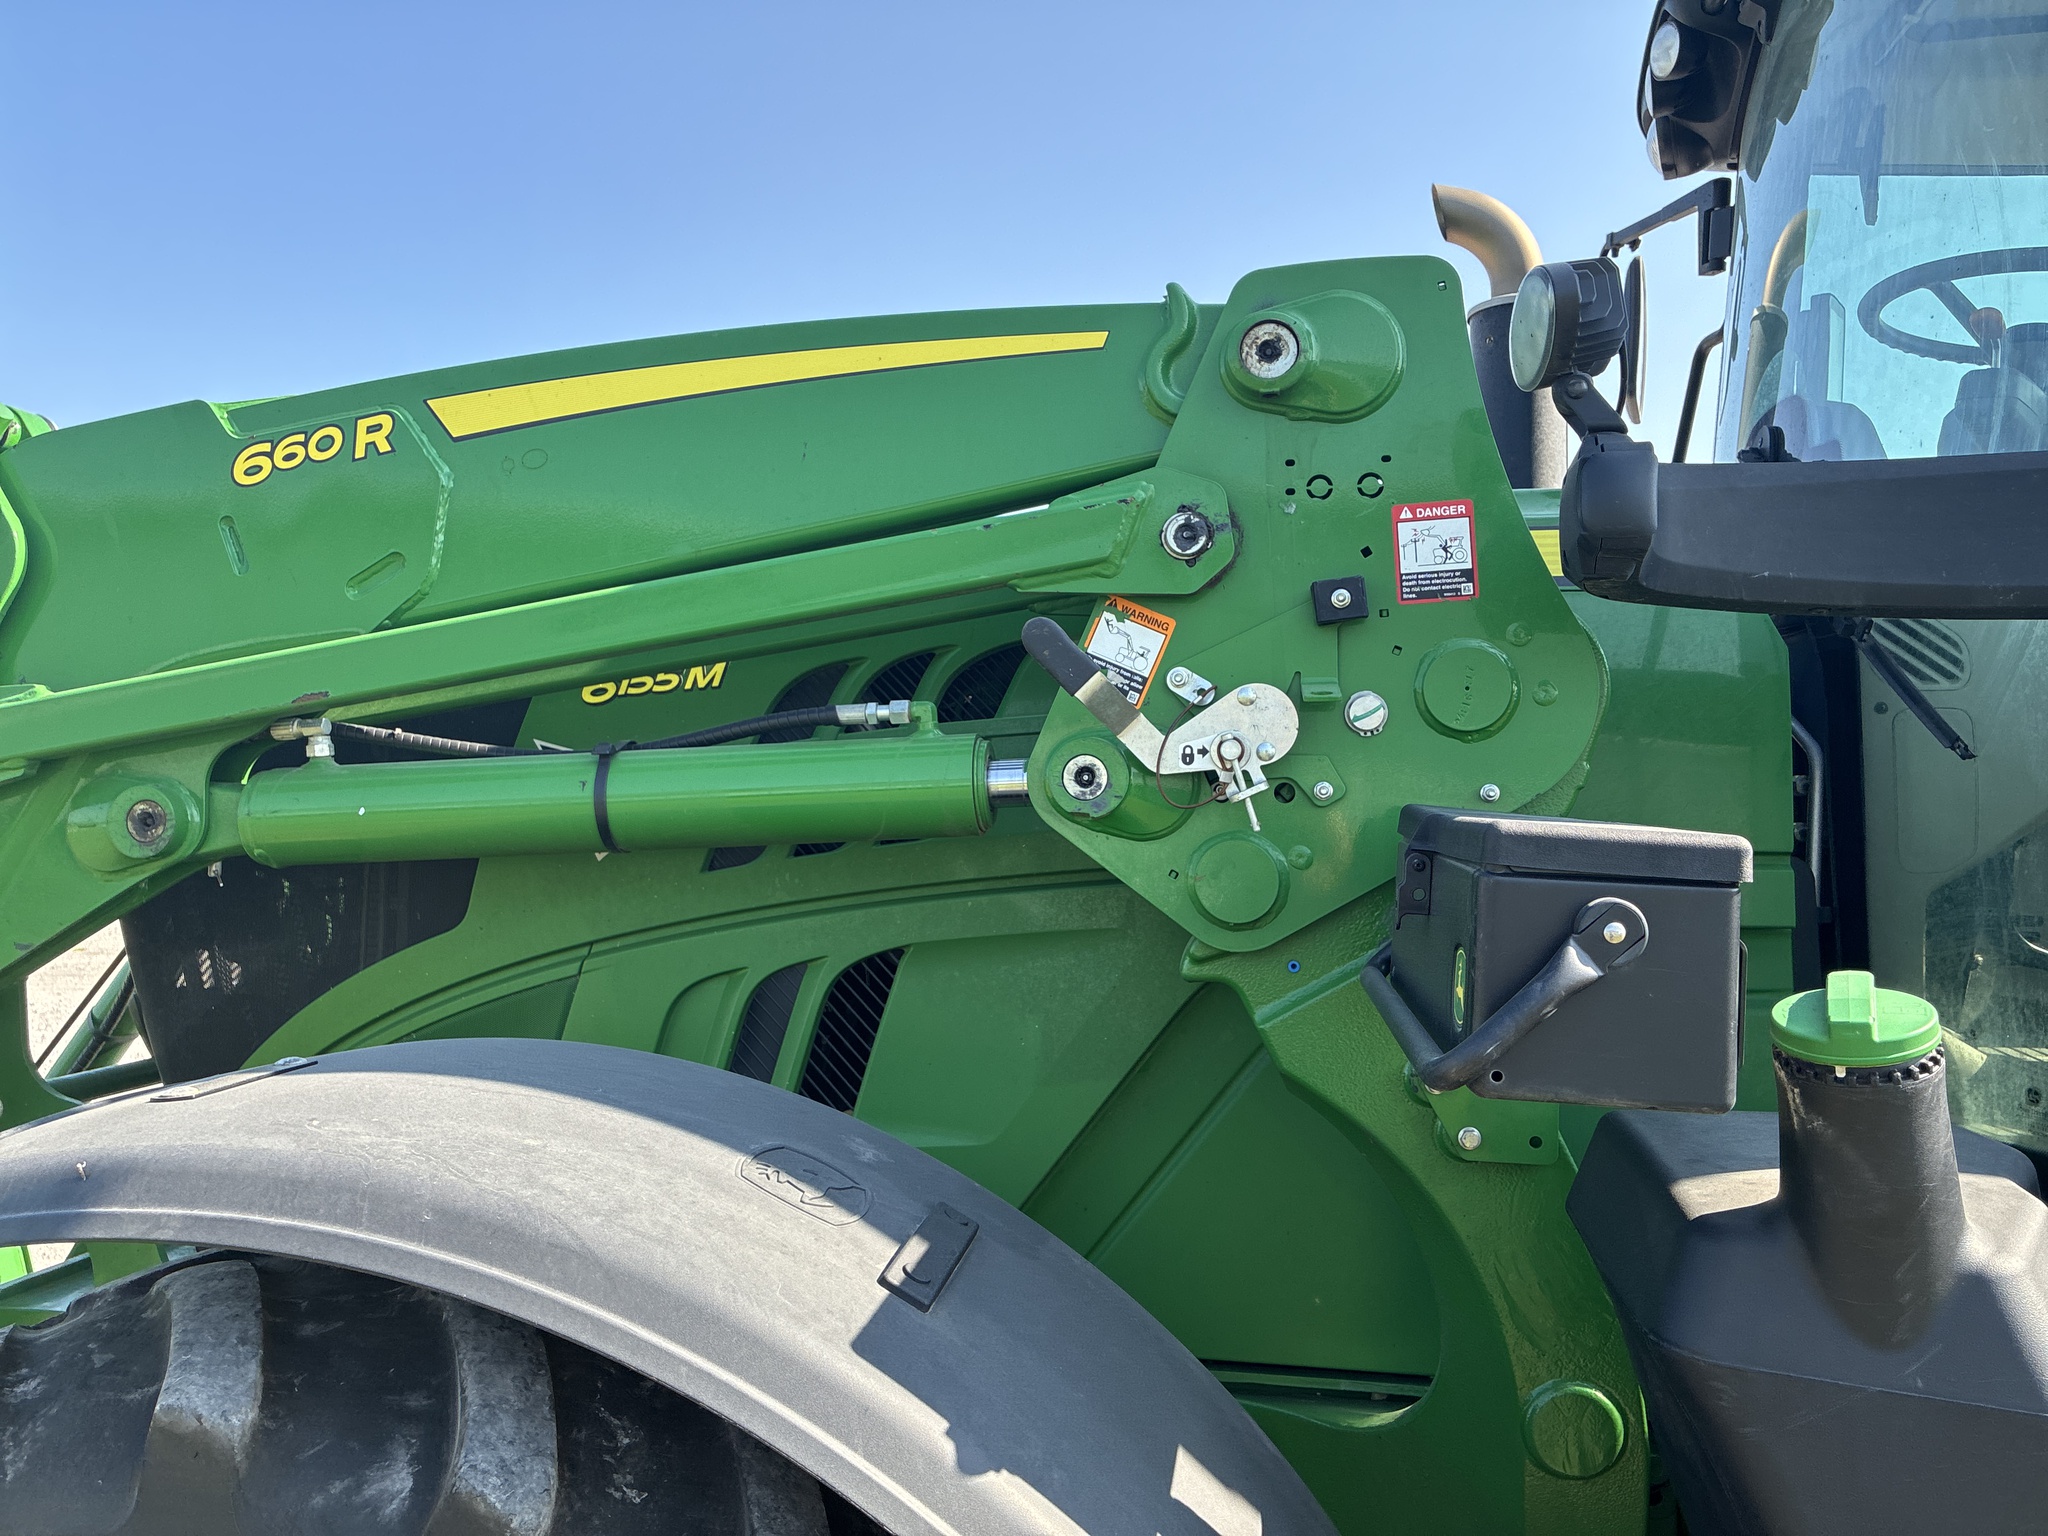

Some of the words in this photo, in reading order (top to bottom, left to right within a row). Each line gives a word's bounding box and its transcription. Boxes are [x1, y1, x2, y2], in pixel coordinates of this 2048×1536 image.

[231, 423, 345, 487] 660
[352, 411, 396, 462] R
[1416, 505, 1466, 518] DANGER
[1121, 604, 1170, 632] WARNING
